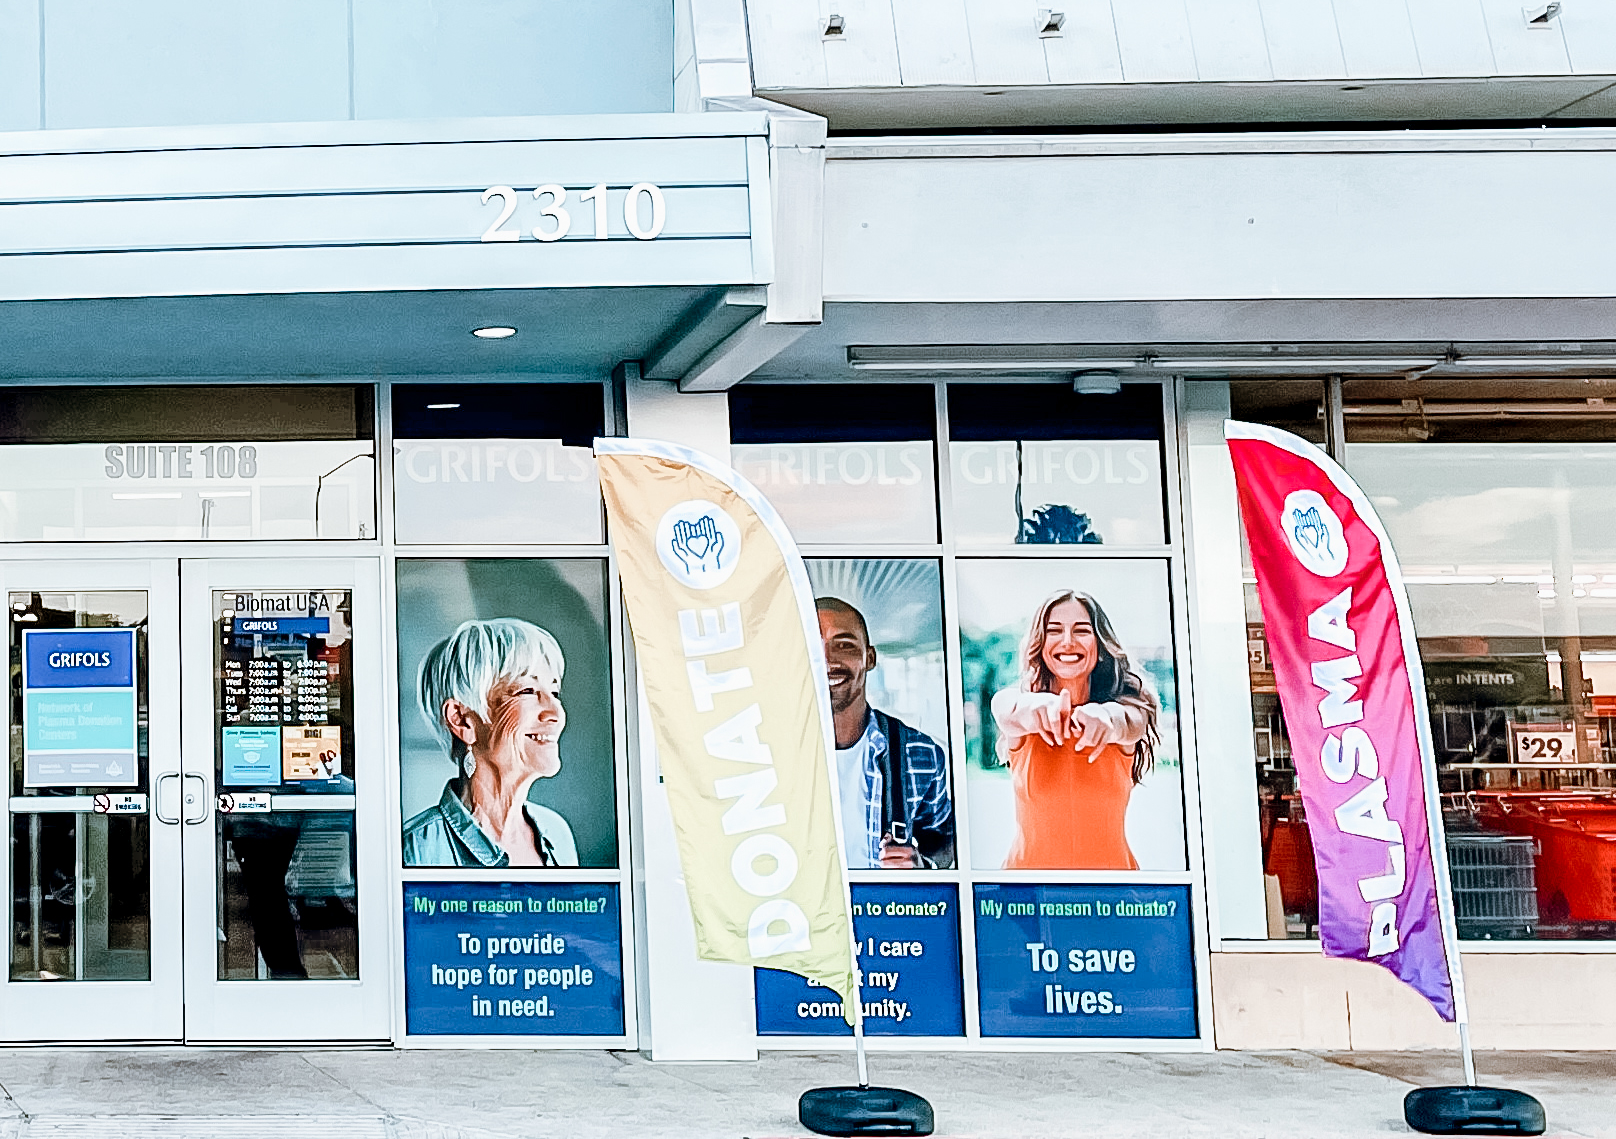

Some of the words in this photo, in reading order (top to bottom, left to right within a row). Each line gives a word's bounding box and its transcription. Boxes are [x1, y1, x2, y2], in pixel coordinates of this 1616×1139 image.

[480, 182, 666, 242] 2310
[105, 445, 192, 479] SUITE
[200, 444, 257, 478] 108
[405, 445, 589, 483] GRIFOLS
[961, 445, 1150, 485] GRIFOLS
[235, 594, 291, 612] Biomat
[297, 594, 330, 612] USA
[242, 621, 277, 631] GRIFOLS
[49, 652, 111, 668] GRIFOLS
[38, 703, 80, 714] Network
[83, 702, 94, 712] of
[38, 715, 76, 727] Plasma
[78, 715, 123, 726] Donation
[1521, 736, 1563, 758] $29
[678, 601, 812, 958] DONATE
[1307, 586, 1406, 958] PLASMA
[414, 897, 436, 916] My
[440, 900, 468, 913] one
[472, 900, 523, 913] reason
[527, 898, 543, 913] to
[546, 897, 607, 914] donate?
[866, 903, 882, 916] to
[885, 901, 947, 916] donate?
[980, 900, 1003, 919] My
[1007, 903, 1035, 916] one
[1039, 903, 1092, 916] reason
[1096, 901, 1111, 916] to
[1115, 900, 1177, 917] donate?
[457, 933, 481, 954] To
[487, 933, 565, 959] provide
[868, 937, 874, 956] I
[879, 941, 923, 956] care
[1026, 942, 1059, 972] To
[1068, 948, 1136, 973] save
[431, 964, 483, 990] hope
[487, 964, 518, 985] for
[524, 964, 593, 990] people
[868, 972, 899, 992] my
[472, 995, 492, 1016] in
[498, 995, 555, 1016] need.
[797, 998, 911, 1021] comunity.
[1045, 984, 1123, 1014] lives.
